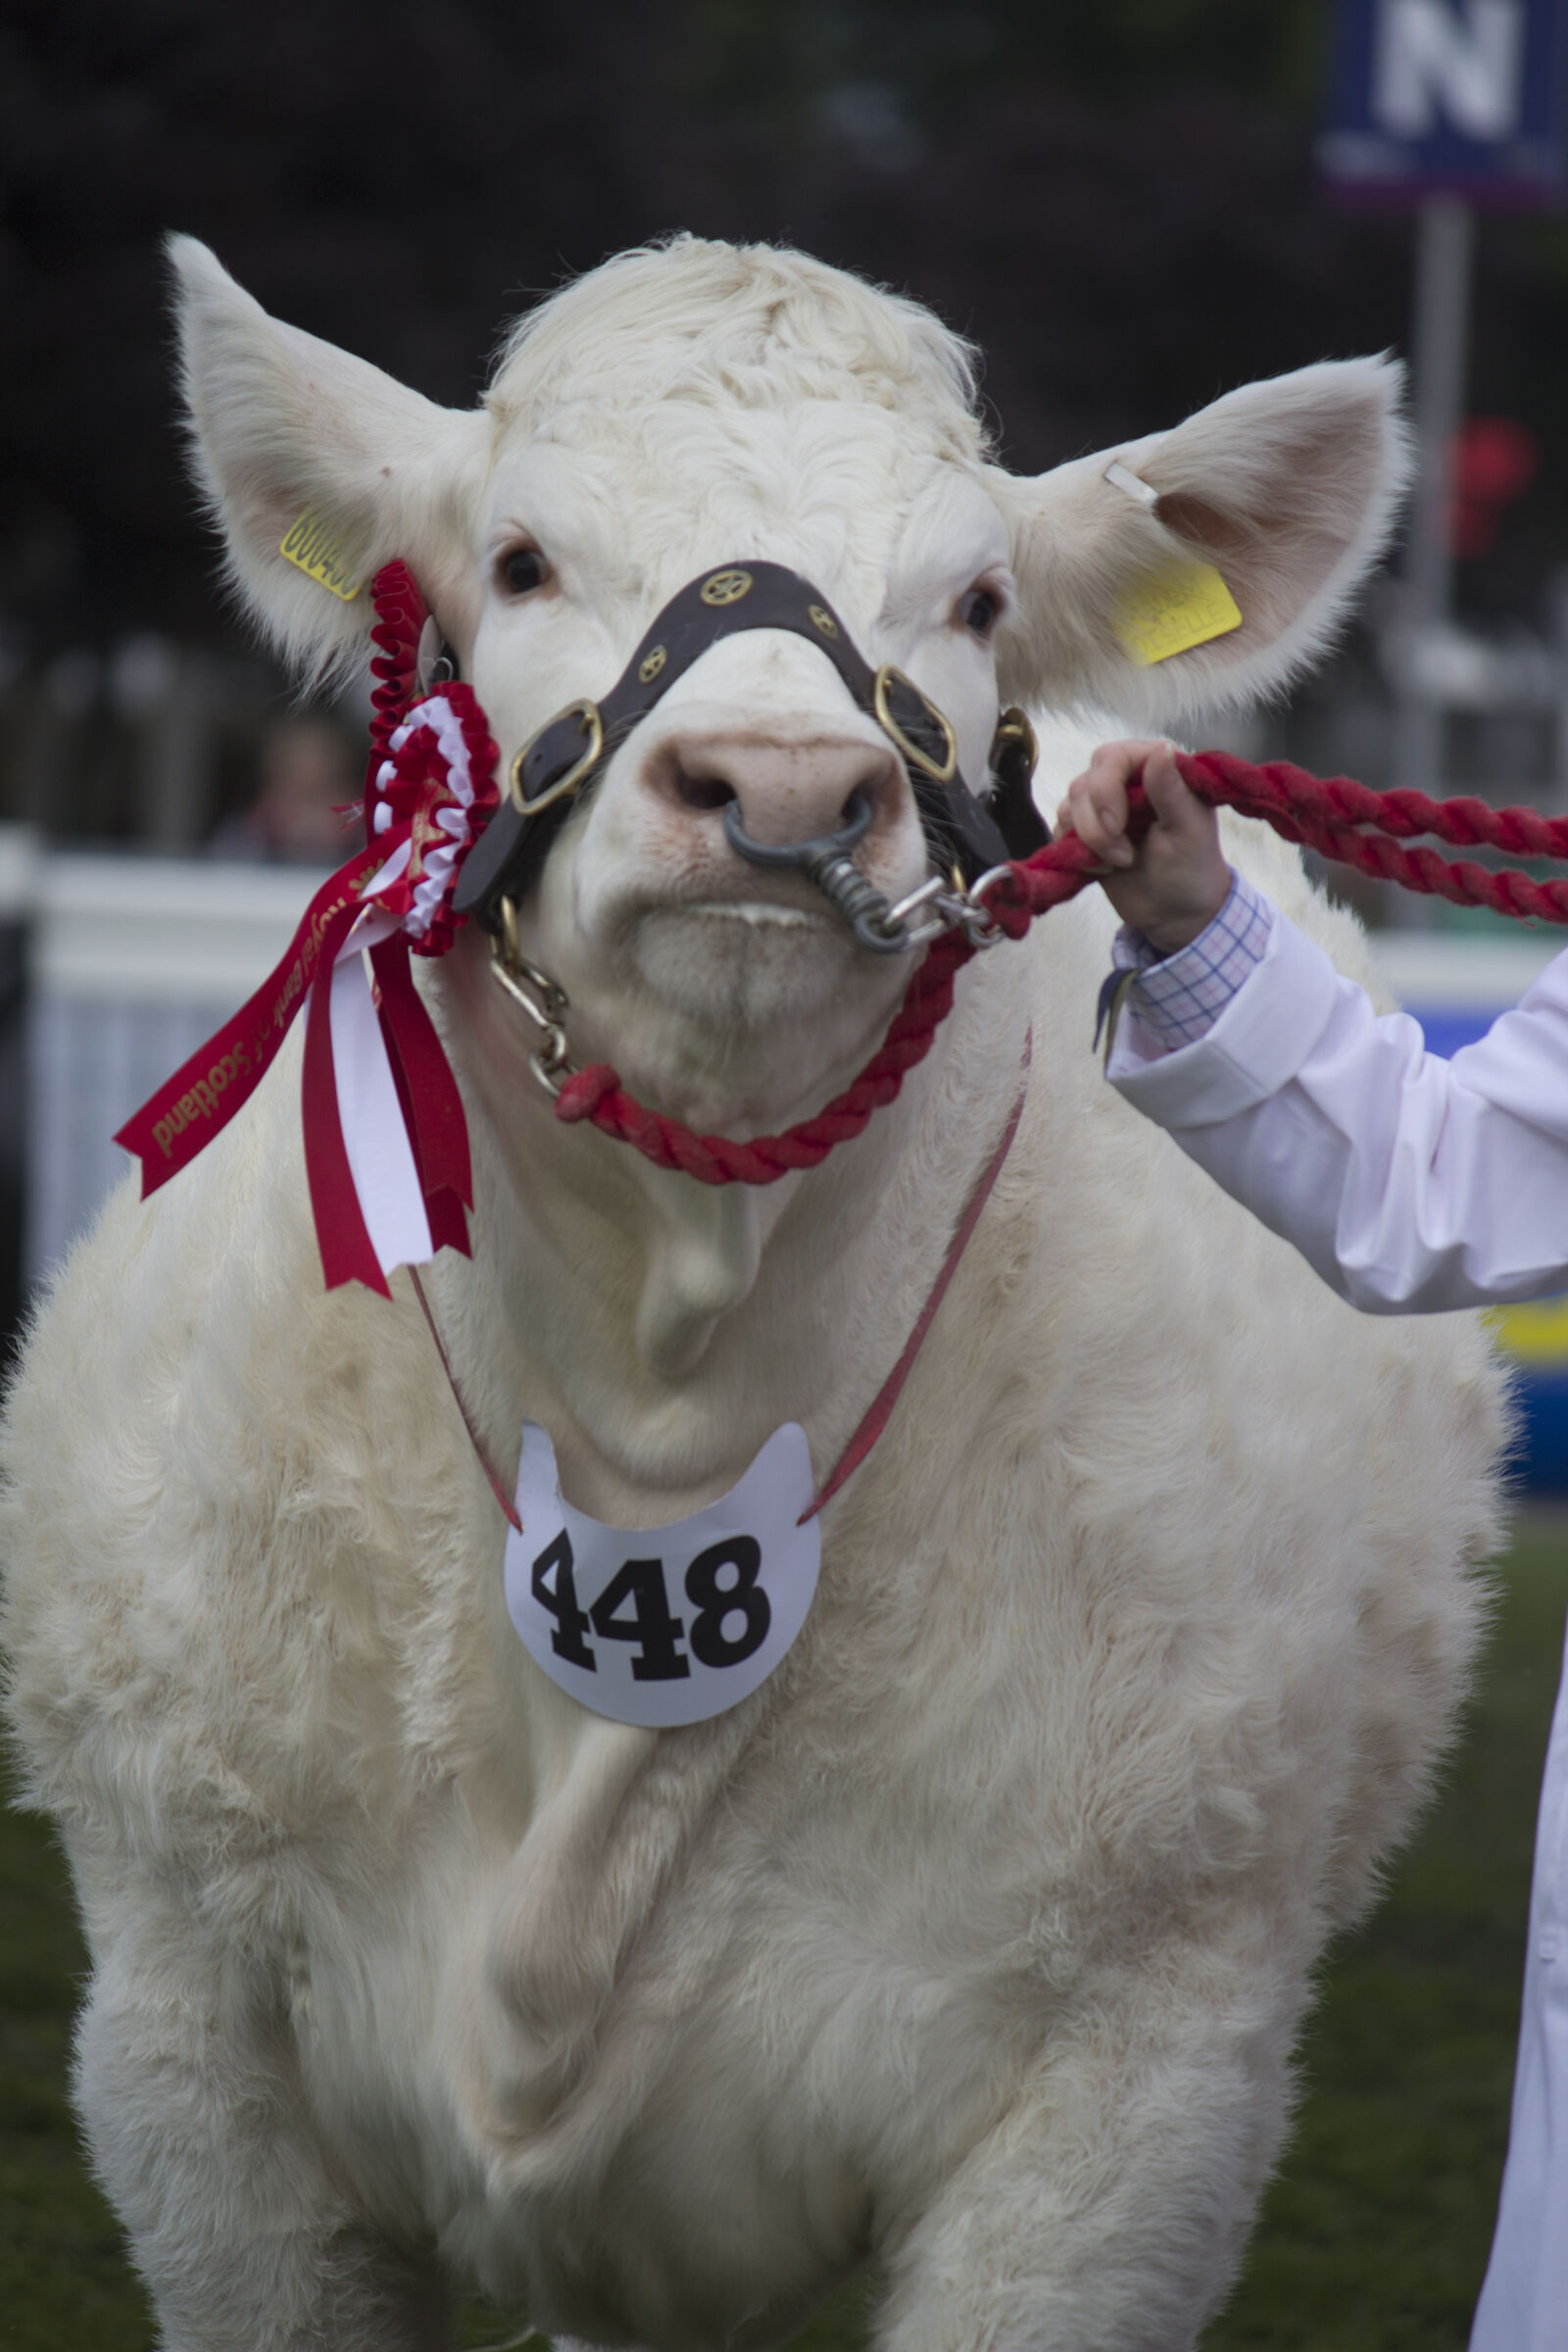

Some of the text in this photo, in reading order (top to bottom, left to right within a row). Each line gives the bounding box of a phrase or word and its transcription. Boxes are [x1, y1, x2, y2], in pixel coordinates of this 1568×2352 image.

[1372, 0, 1525, 139] N
[271, 958, 304, 1029] Bank
[151, 1041, 252, 1158] Scotland
[531, 1528, 771, 1681] 448
